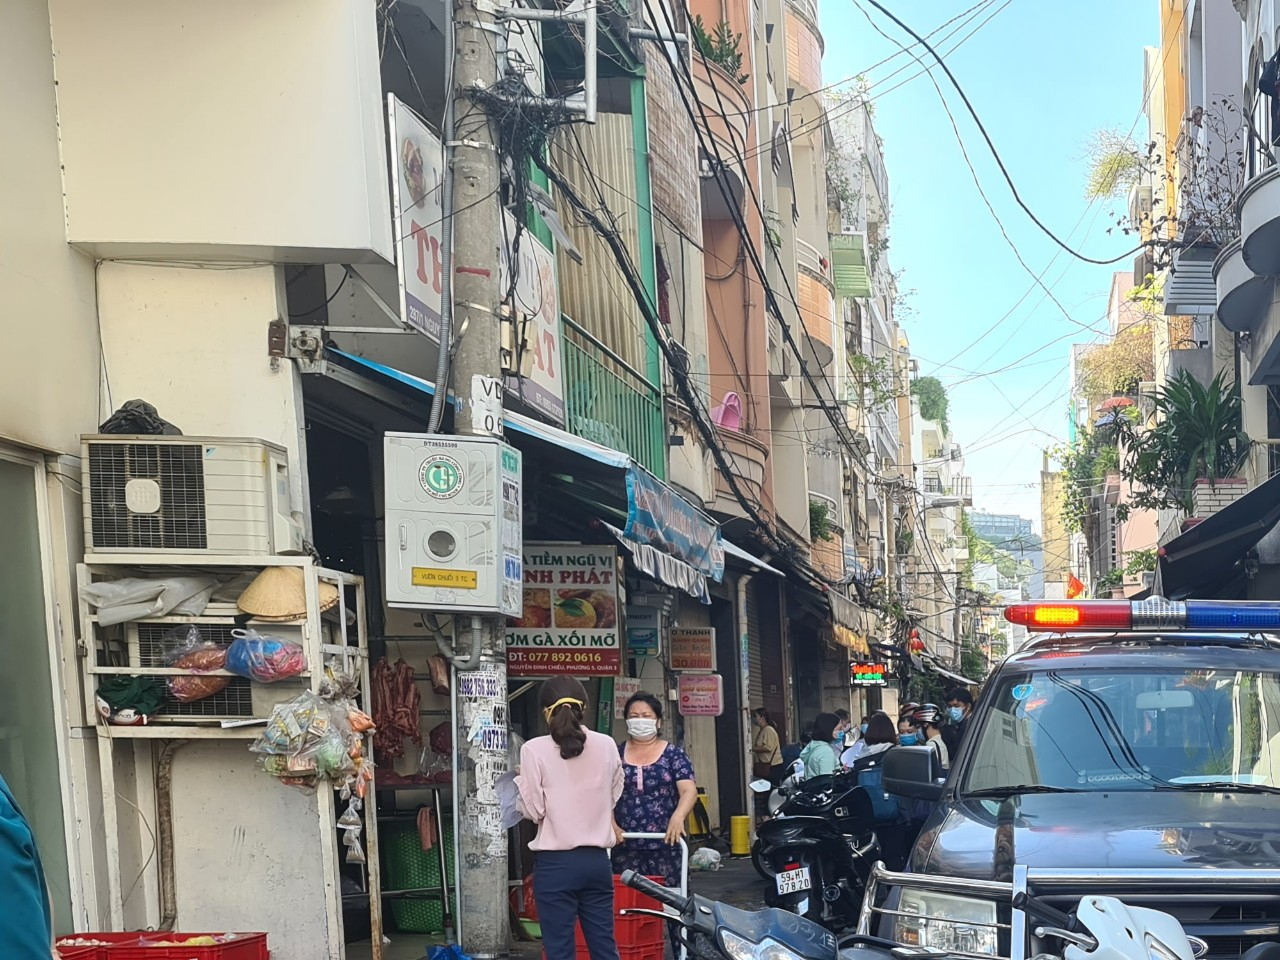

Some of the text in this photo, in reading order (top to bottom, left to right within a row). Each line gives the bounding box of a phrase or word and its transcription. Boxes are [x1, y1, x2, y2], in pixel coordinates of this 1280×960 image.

[531, 551, 563, 566] TIỀM
[566, 553, 595, 567] NGŨ
[597, 556, 612, 569] VỊ
[559, 567, 613, 585] PHÁT
[506, 630, 616, 646] ƠM GÀ XỐI MỠ
[508, 652, 601, 662] ĐT: 077 892 0616
